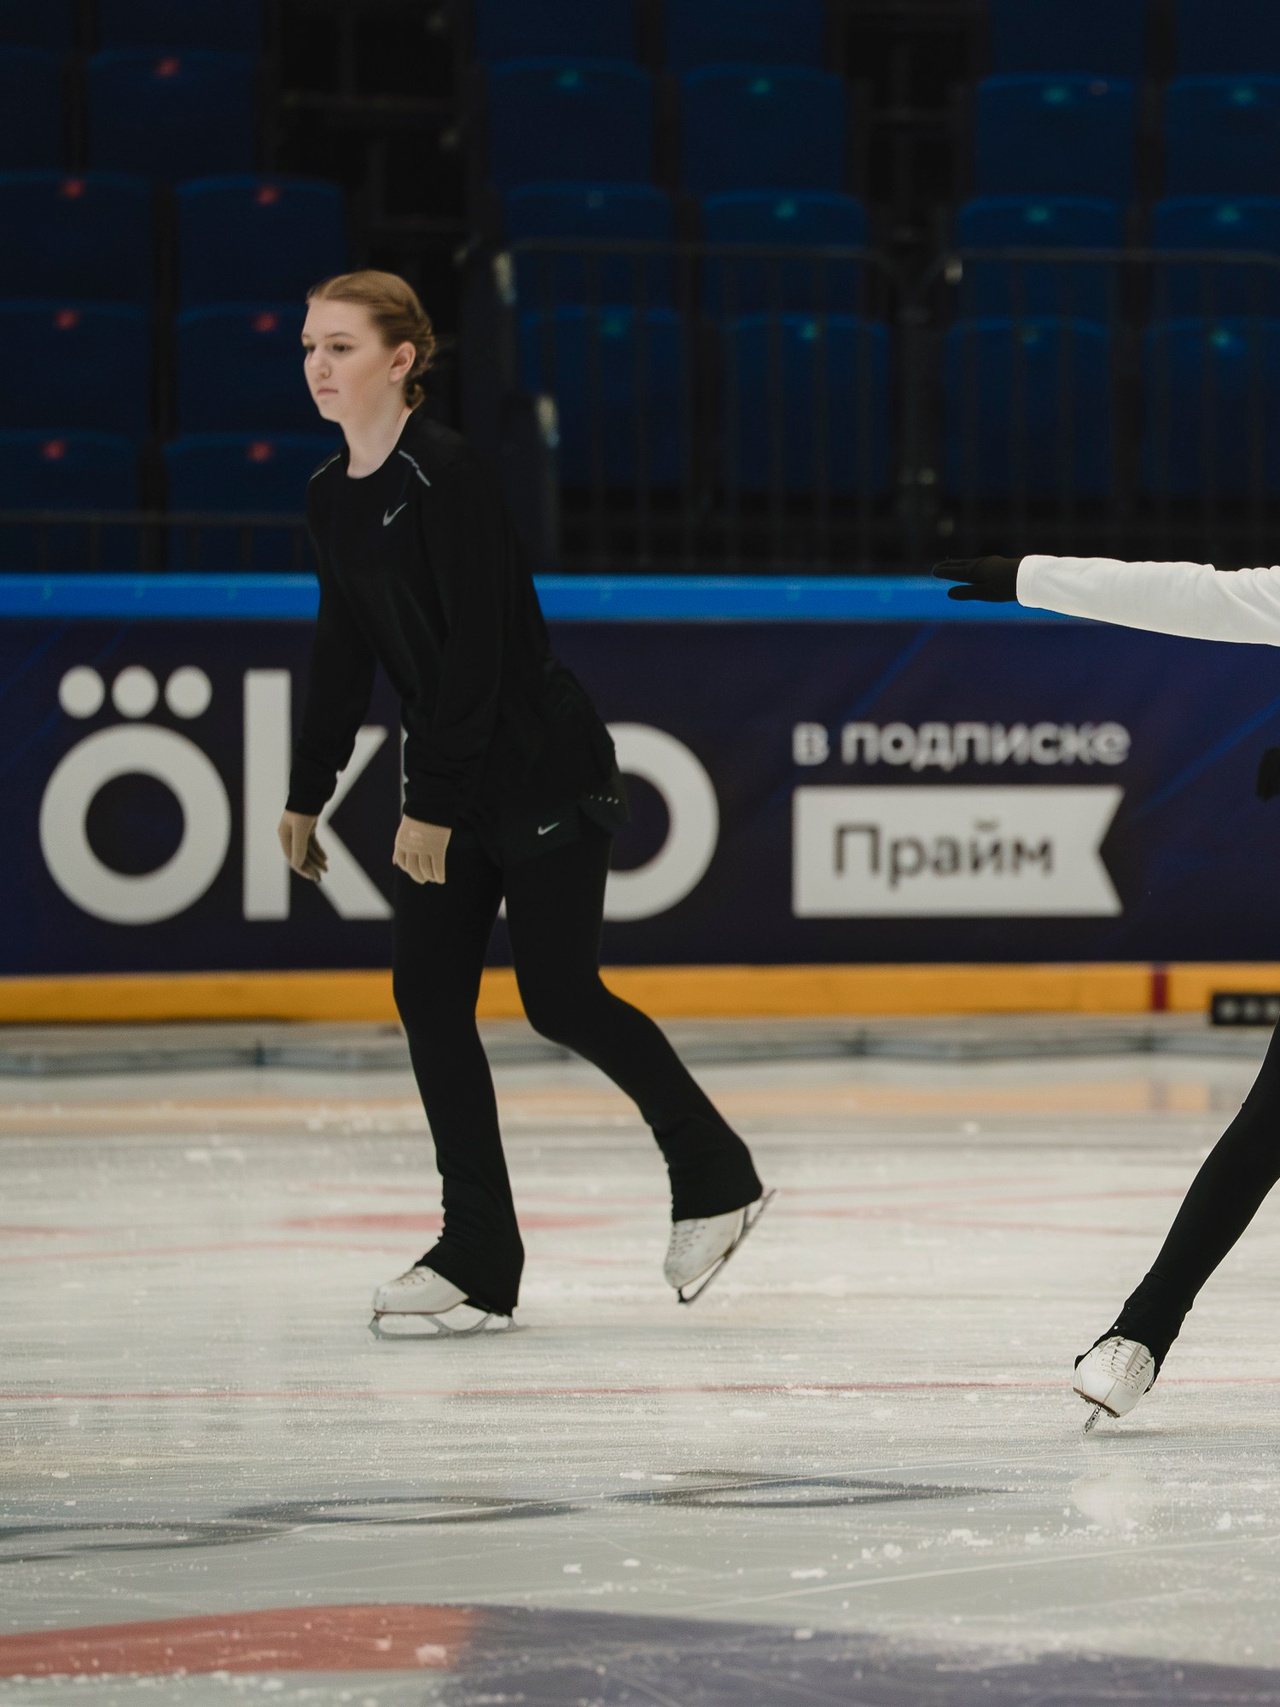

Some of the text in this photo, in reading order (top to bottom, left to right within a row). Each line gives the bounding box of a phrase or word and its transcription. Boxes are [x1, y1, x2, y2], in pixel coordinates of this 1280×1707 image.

[792, 722, 1131, 772] в подписке
[834, 820, 1055, 888] Прайм
